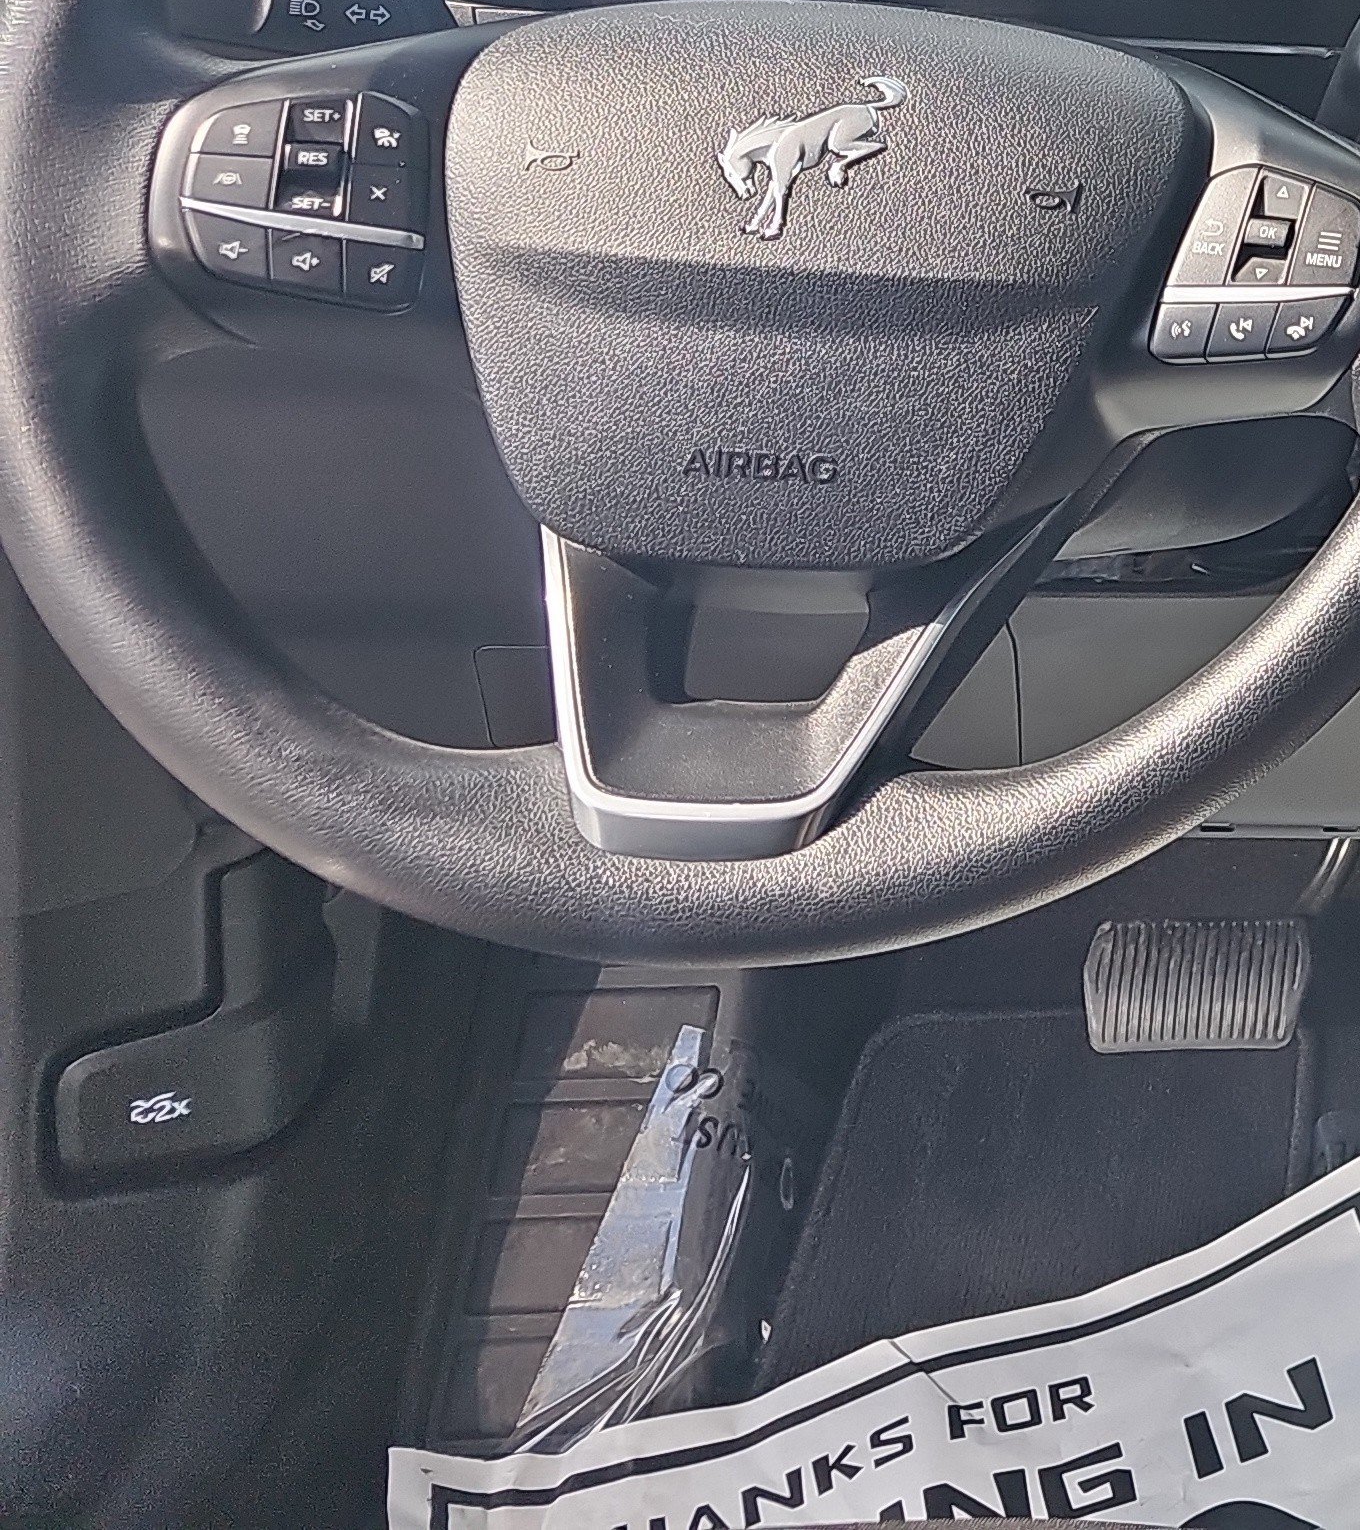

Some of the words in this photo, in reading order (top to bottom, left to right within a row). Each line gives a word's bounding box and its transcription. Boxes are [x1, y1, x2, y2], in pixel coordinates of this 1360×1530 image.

[303, 109, 342, 122] SET+
[298, 152, 328, 166] RES
[1259, 226, 1278, 239] OK
[1192, 241, 1226, 255] BACK
[1306, 252, 1343, 268] MENU
[681, 447, 839, 485] AIRBAG
[948, 1376, 1096, 1441] FOR
[1183, 1356, 1334, 1480] IN
